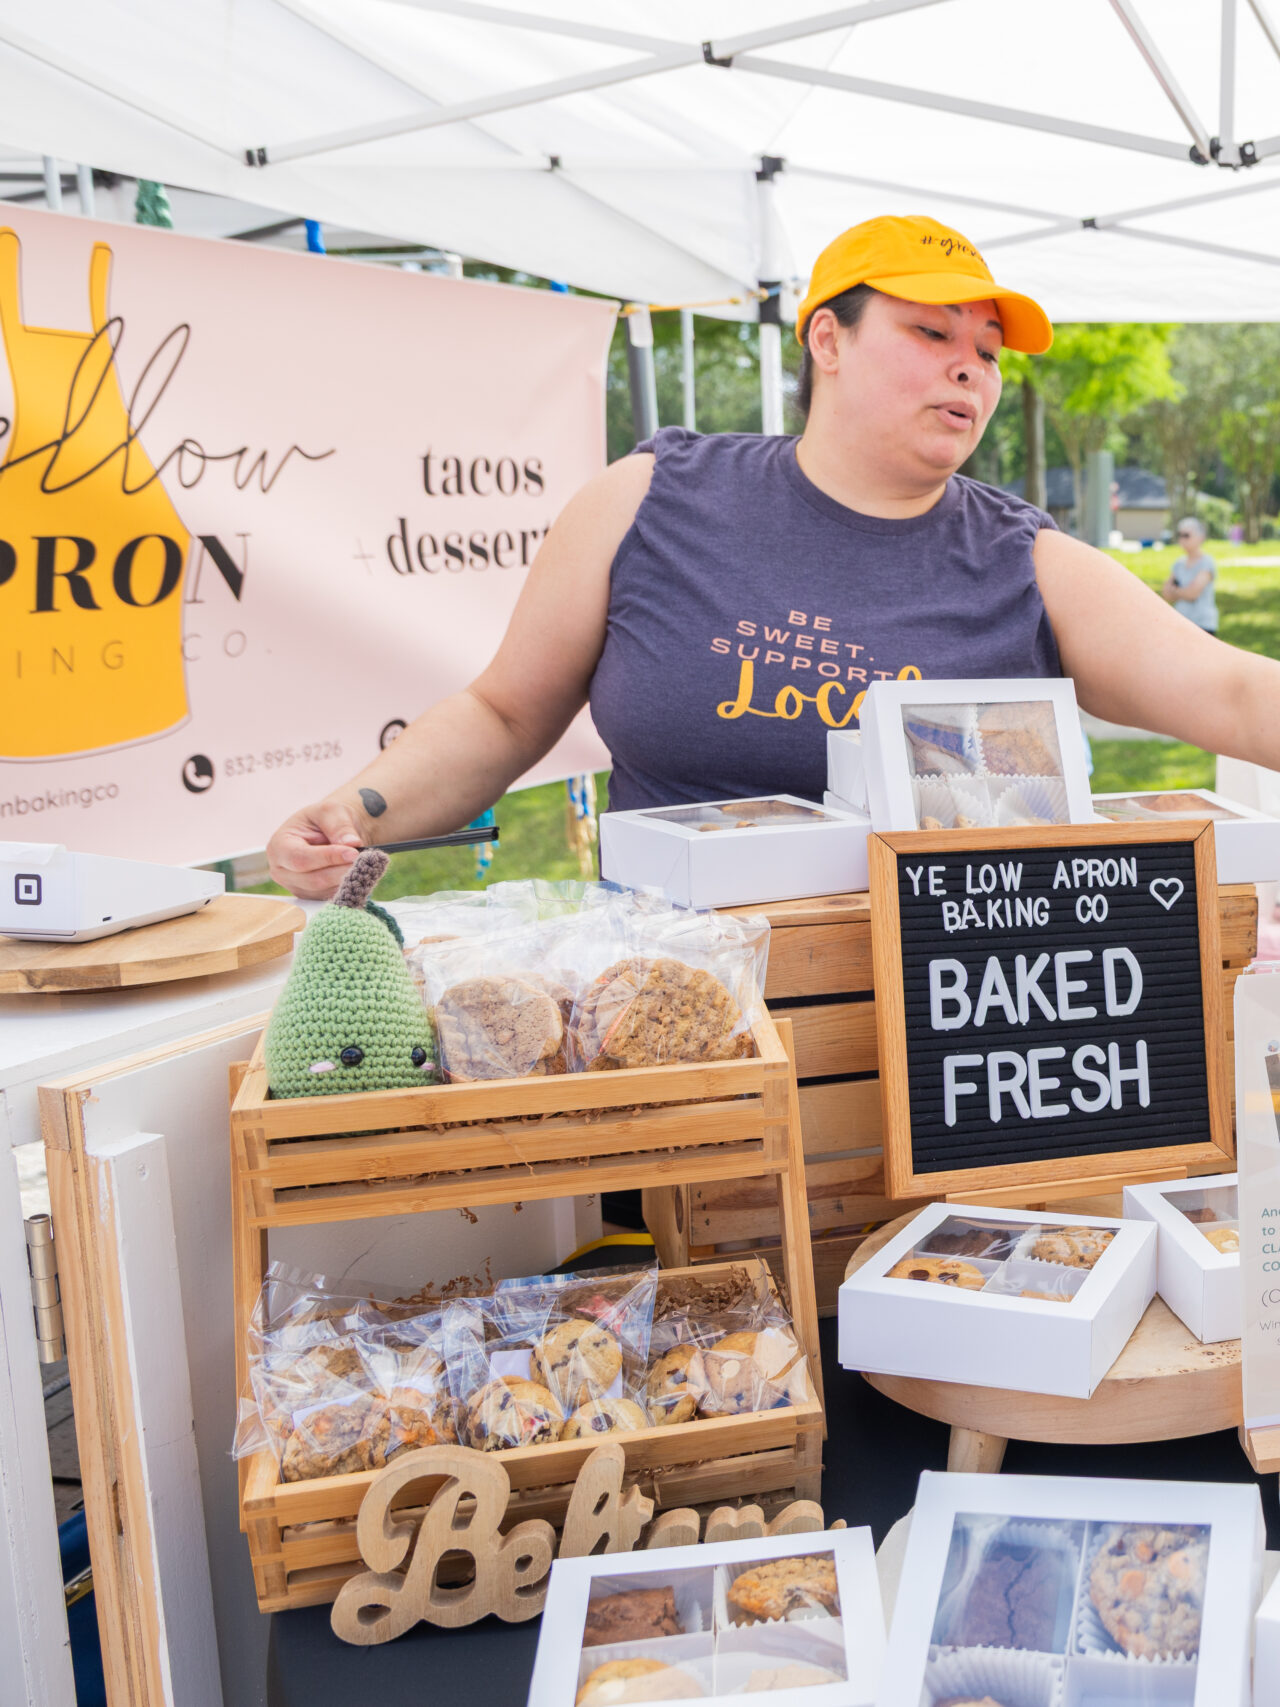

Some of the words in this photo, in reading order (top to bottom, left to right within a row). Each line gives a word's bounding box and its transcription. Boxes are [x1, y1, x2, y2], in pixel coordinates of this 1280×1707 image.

[0, 316, 335, 494] llow
[420, 446, 545, 497] tacos
[386, 517, 552, 575] desser
[0, 534, 251, 613] RON
[736, 620, 875, 662] SWEET.
[788, 609, 833, 632] BE
[710, 637, 894, 683] SUPPORT
[1053, 857, 1138, 890] APRON
[942, 897, 1050, 933] BAKING
[1075, 894, 1109, 924] CO
[929, 947, 1144, 1031] BAKED
[943, 1039, 1150, 1127] FRESH
[1262, 1226, 1276, 1236] to
